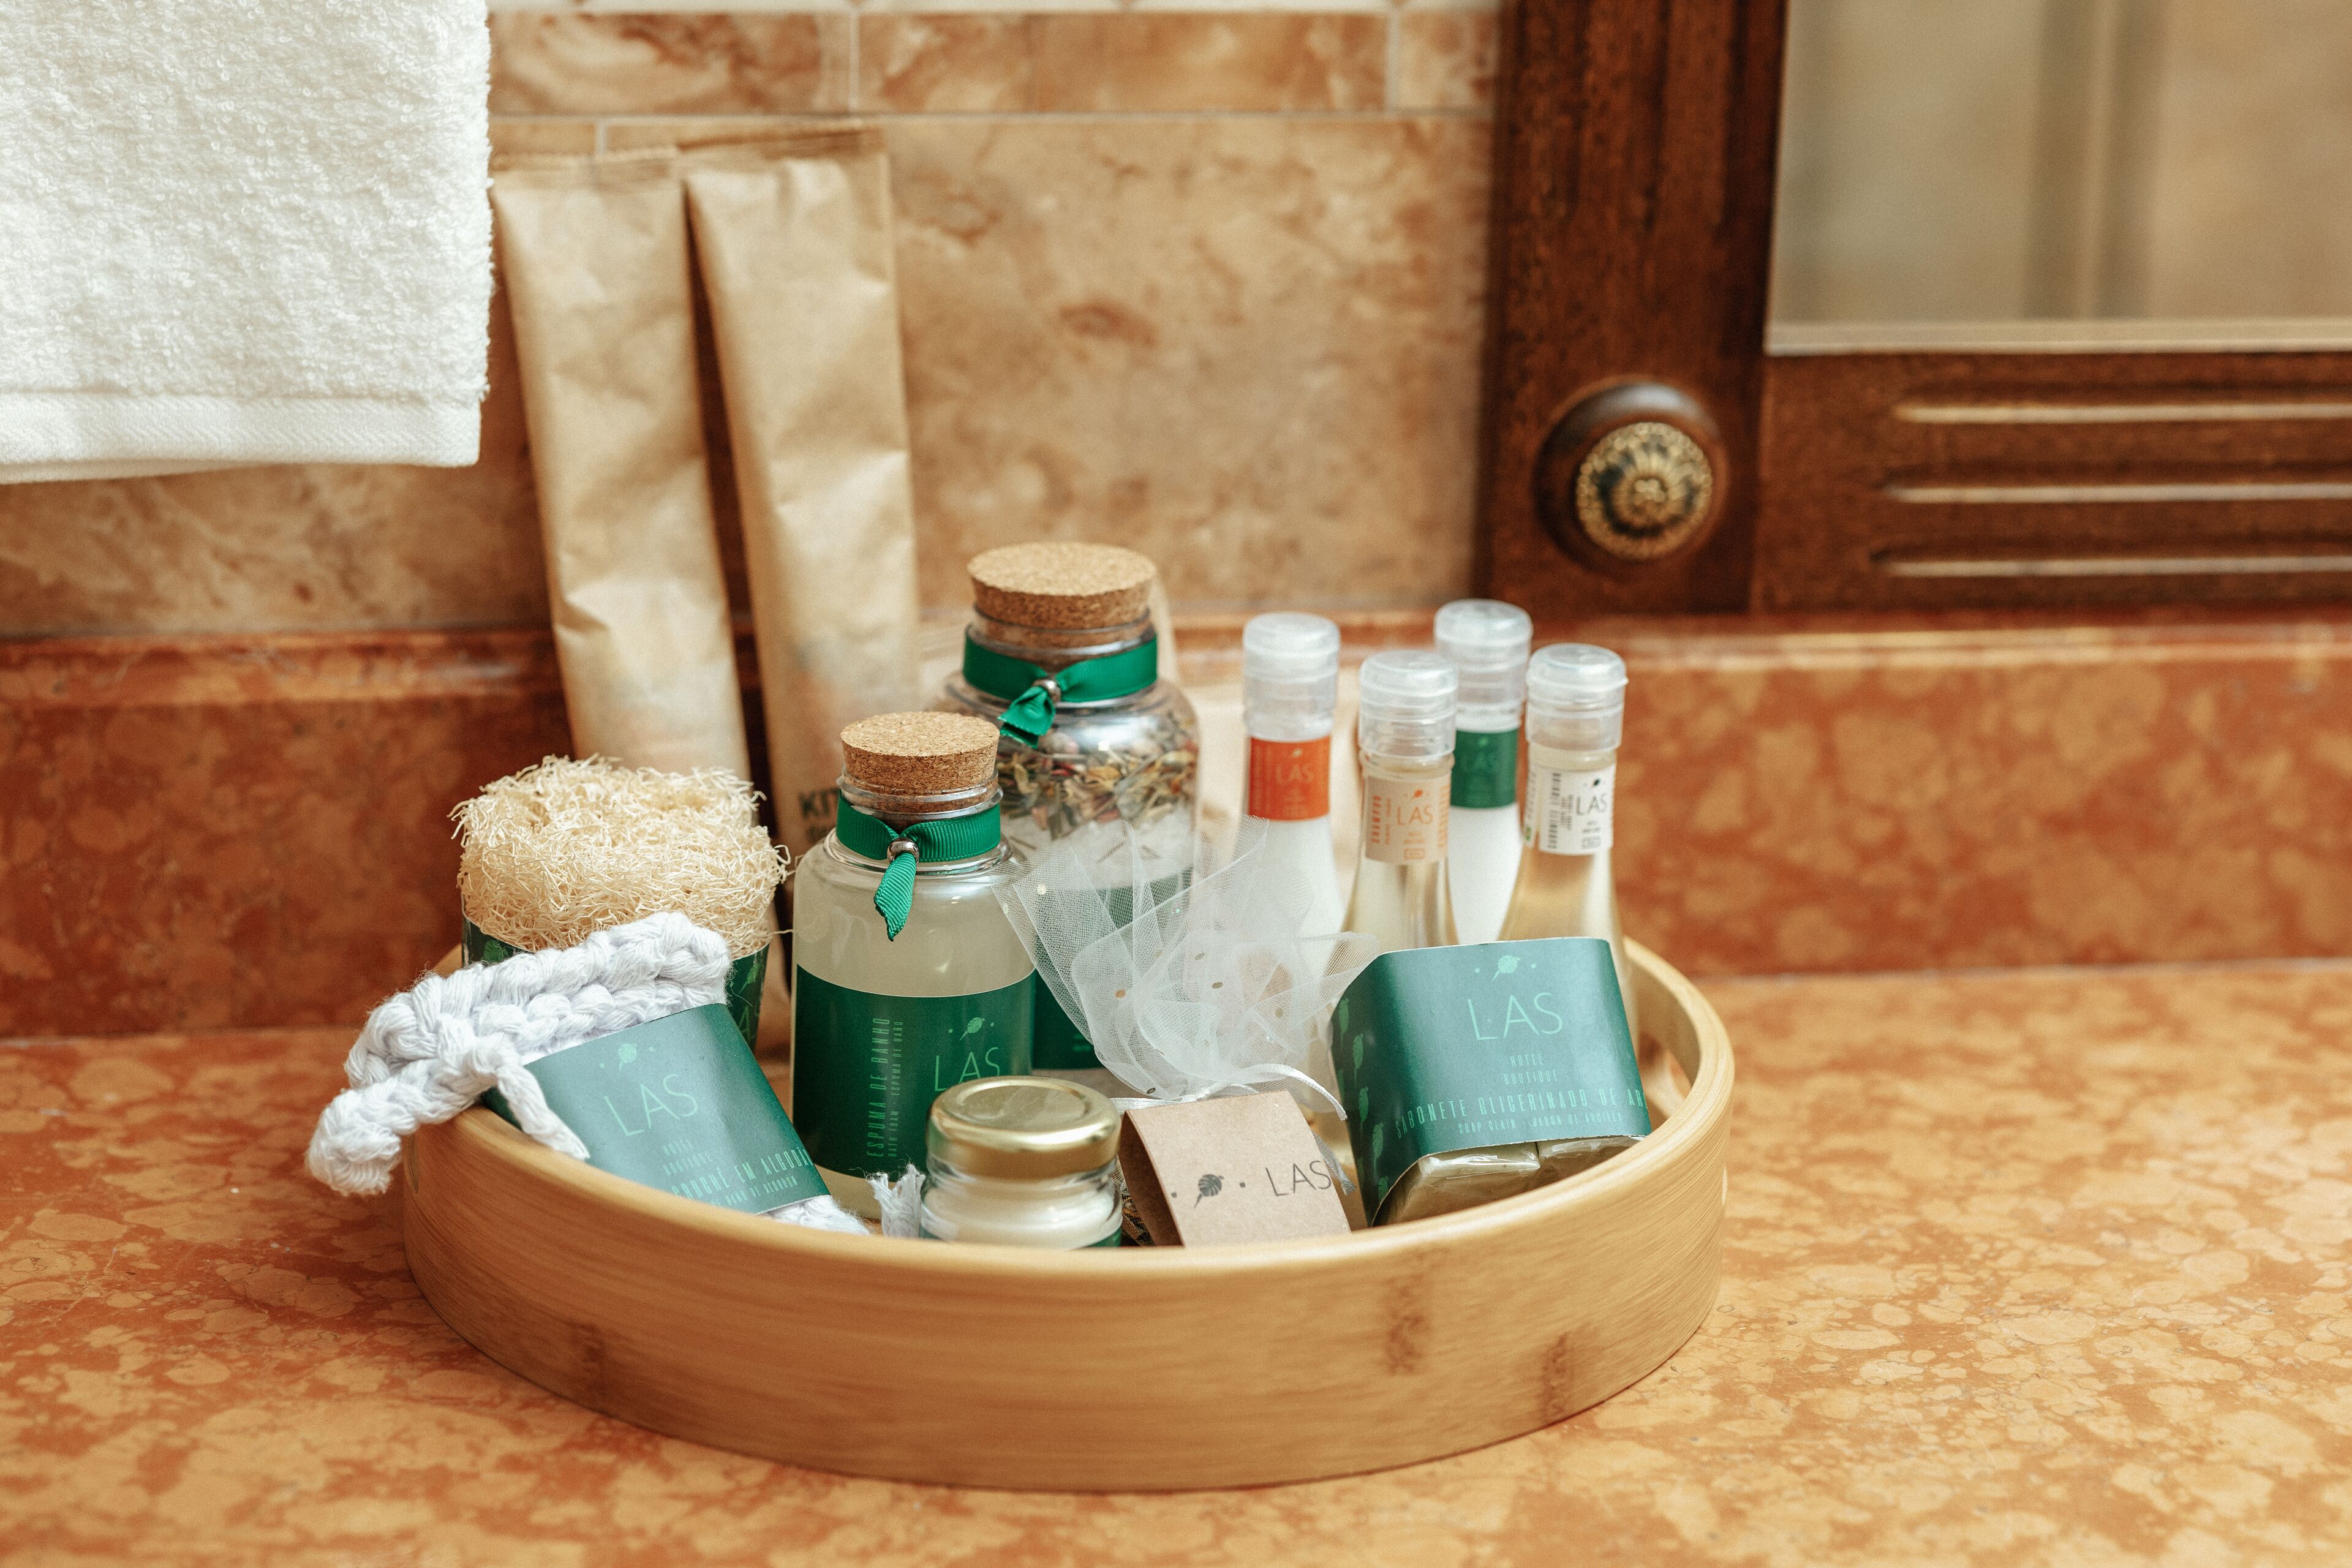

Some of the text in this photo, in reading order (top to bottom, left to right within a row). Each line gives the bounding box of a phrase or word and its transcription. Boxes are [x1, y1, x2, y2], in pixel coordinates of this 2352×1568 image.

[1276, 763, 1314, 785] LAS
[1397, 804, 1434, 826] LAS
[1575, 793, 1608, 816] LAS
[1468, 992, 1563, 1040] LAS
[935, 1046, 1000, 1091] LAS
[1510, 1054, 1544, 1067] HOTEL
[867, 1018, 890, 1157] ESPUMA DE BANHO
[1503, 1069, 1558, 1085] BOUTIQUE
[604, 1074, 698, 1137] LAS
[1395, 1099, 1467, 1139] SABONETE
[1478, 1089, 1588, 1115] GLICERINADO
[1599, 1088, 1618, 1106] DE
[1458, 1121, 1481, 1134] SOAP
[734, 1162, 756, 1183] EM
[1265, 1160, 1332, 1196] LAS
